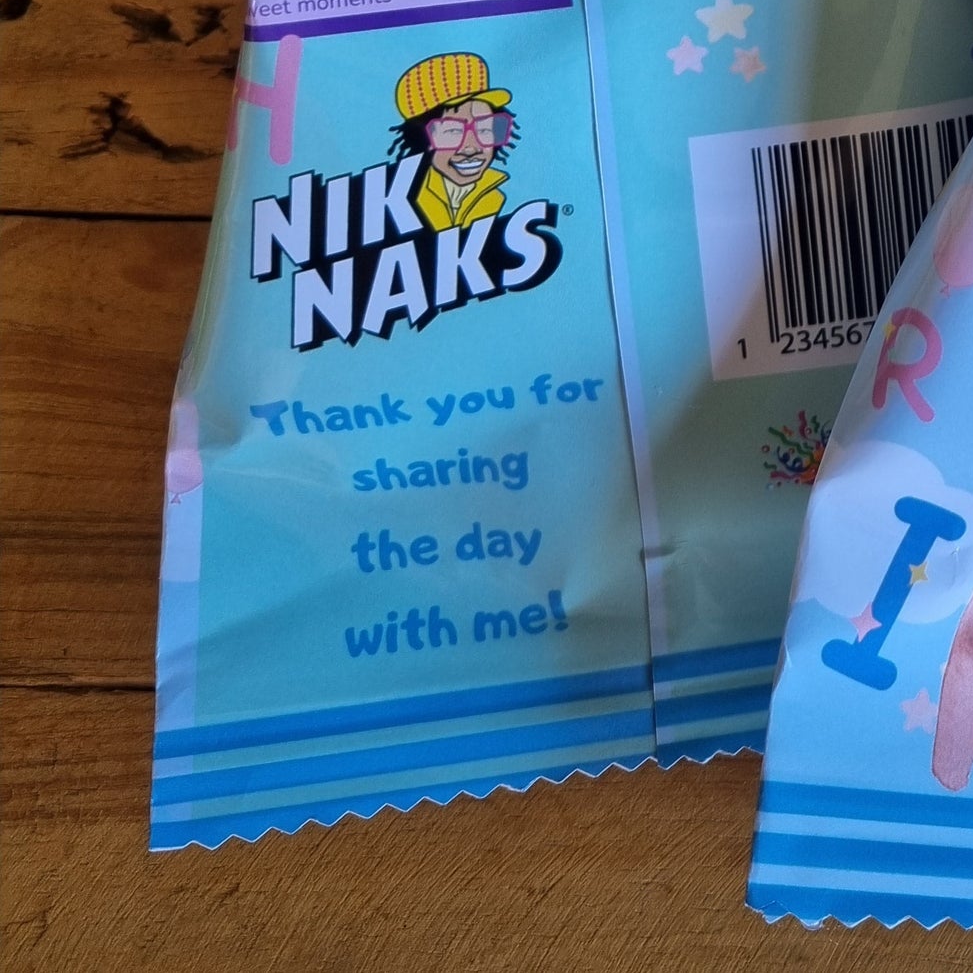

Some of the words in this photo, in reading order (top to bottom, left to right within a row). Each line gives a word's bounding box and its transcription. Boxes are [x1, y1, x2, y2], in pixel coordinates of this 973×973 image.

[250, 152, 427, 282] NIK
[737, 337, 747, 359] 1
[872, 307, 942, 422] R
[250, 393, 412, 437] Thank
[426, 385, 515, 426] you
[530, 373, 604, 405] for
[353, 448, 528, 491] sharing
[351, 529, 439, 573] the
[456, 522, 542, 566] day
[345, 606, 457, 658] with
[474, 589, 569, 643] me!
